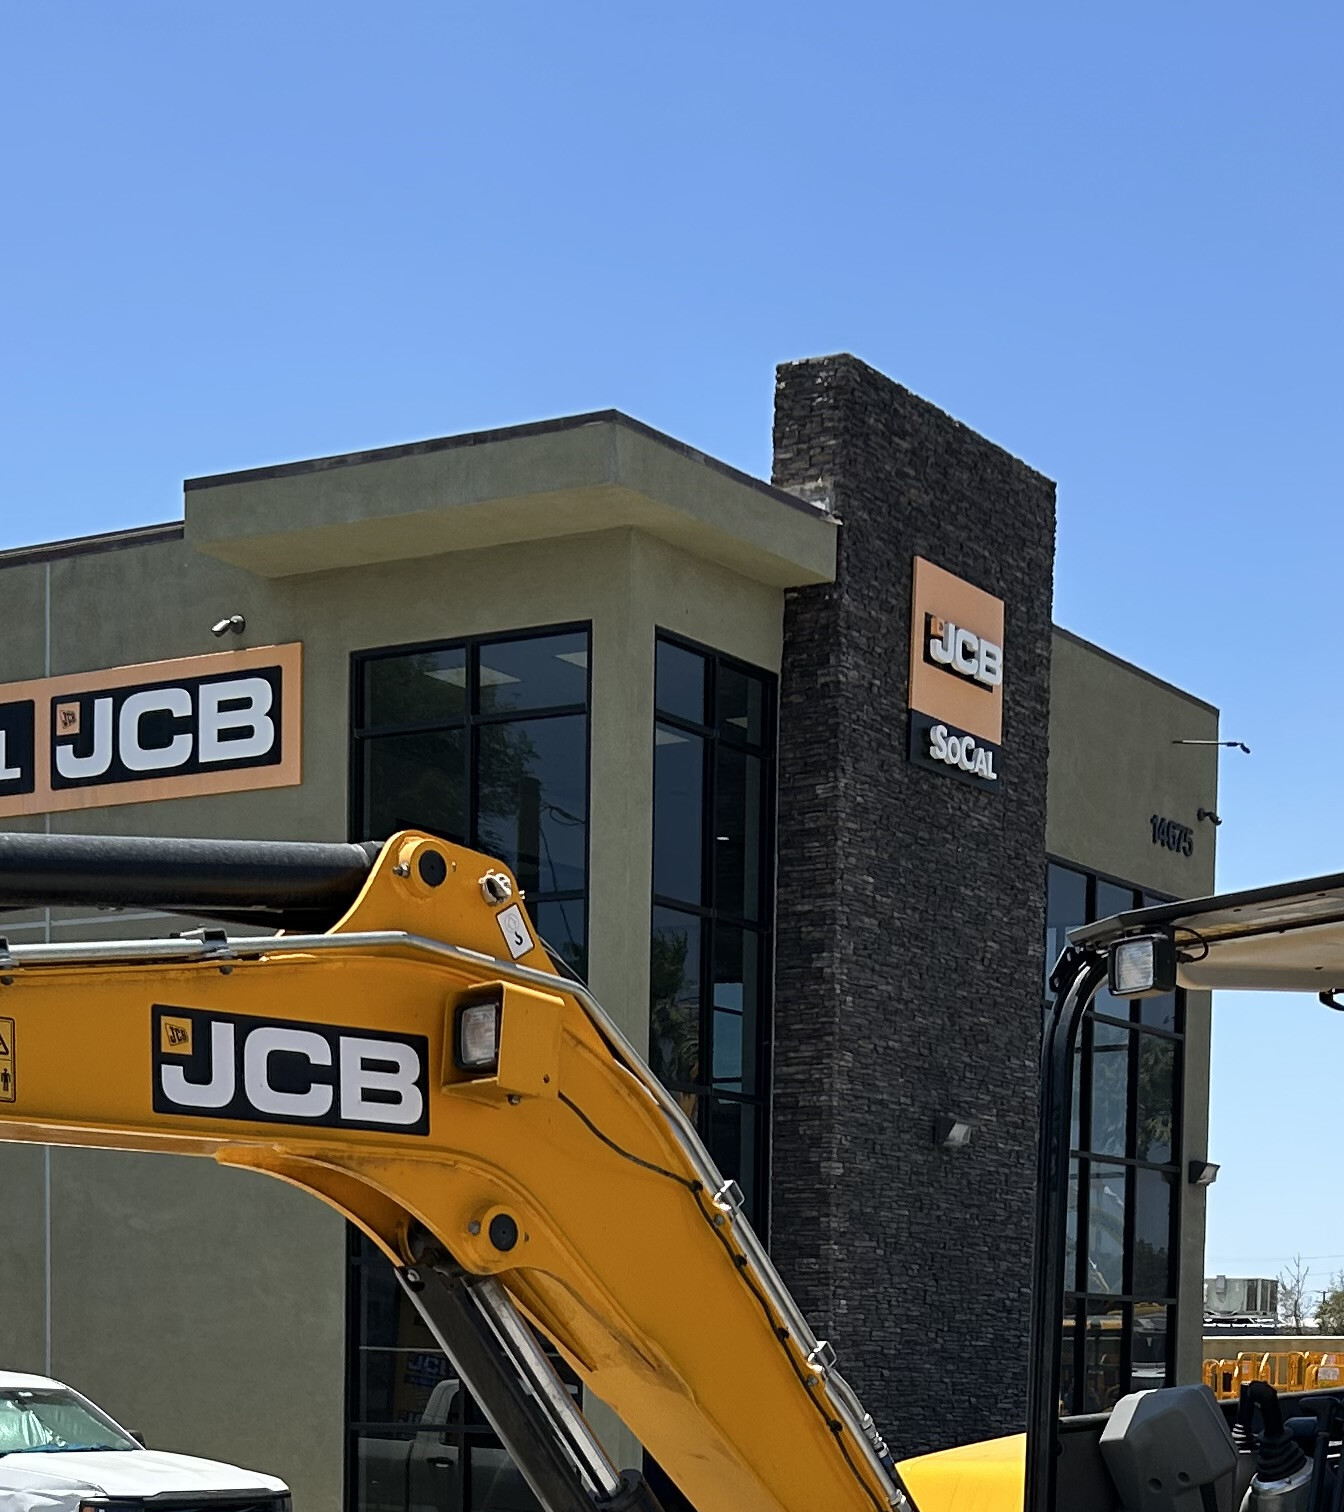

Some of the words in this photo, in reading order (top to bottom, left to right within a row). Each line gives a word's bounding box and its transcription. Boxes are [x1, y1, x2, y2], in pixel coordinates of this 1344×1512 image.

[930, 622, 1003, 686] JCB
[56, 677, 276, 780] JCB
[1150, 814, 1194, 857] 14675
[161, 1021, 424, 1126] JCB
